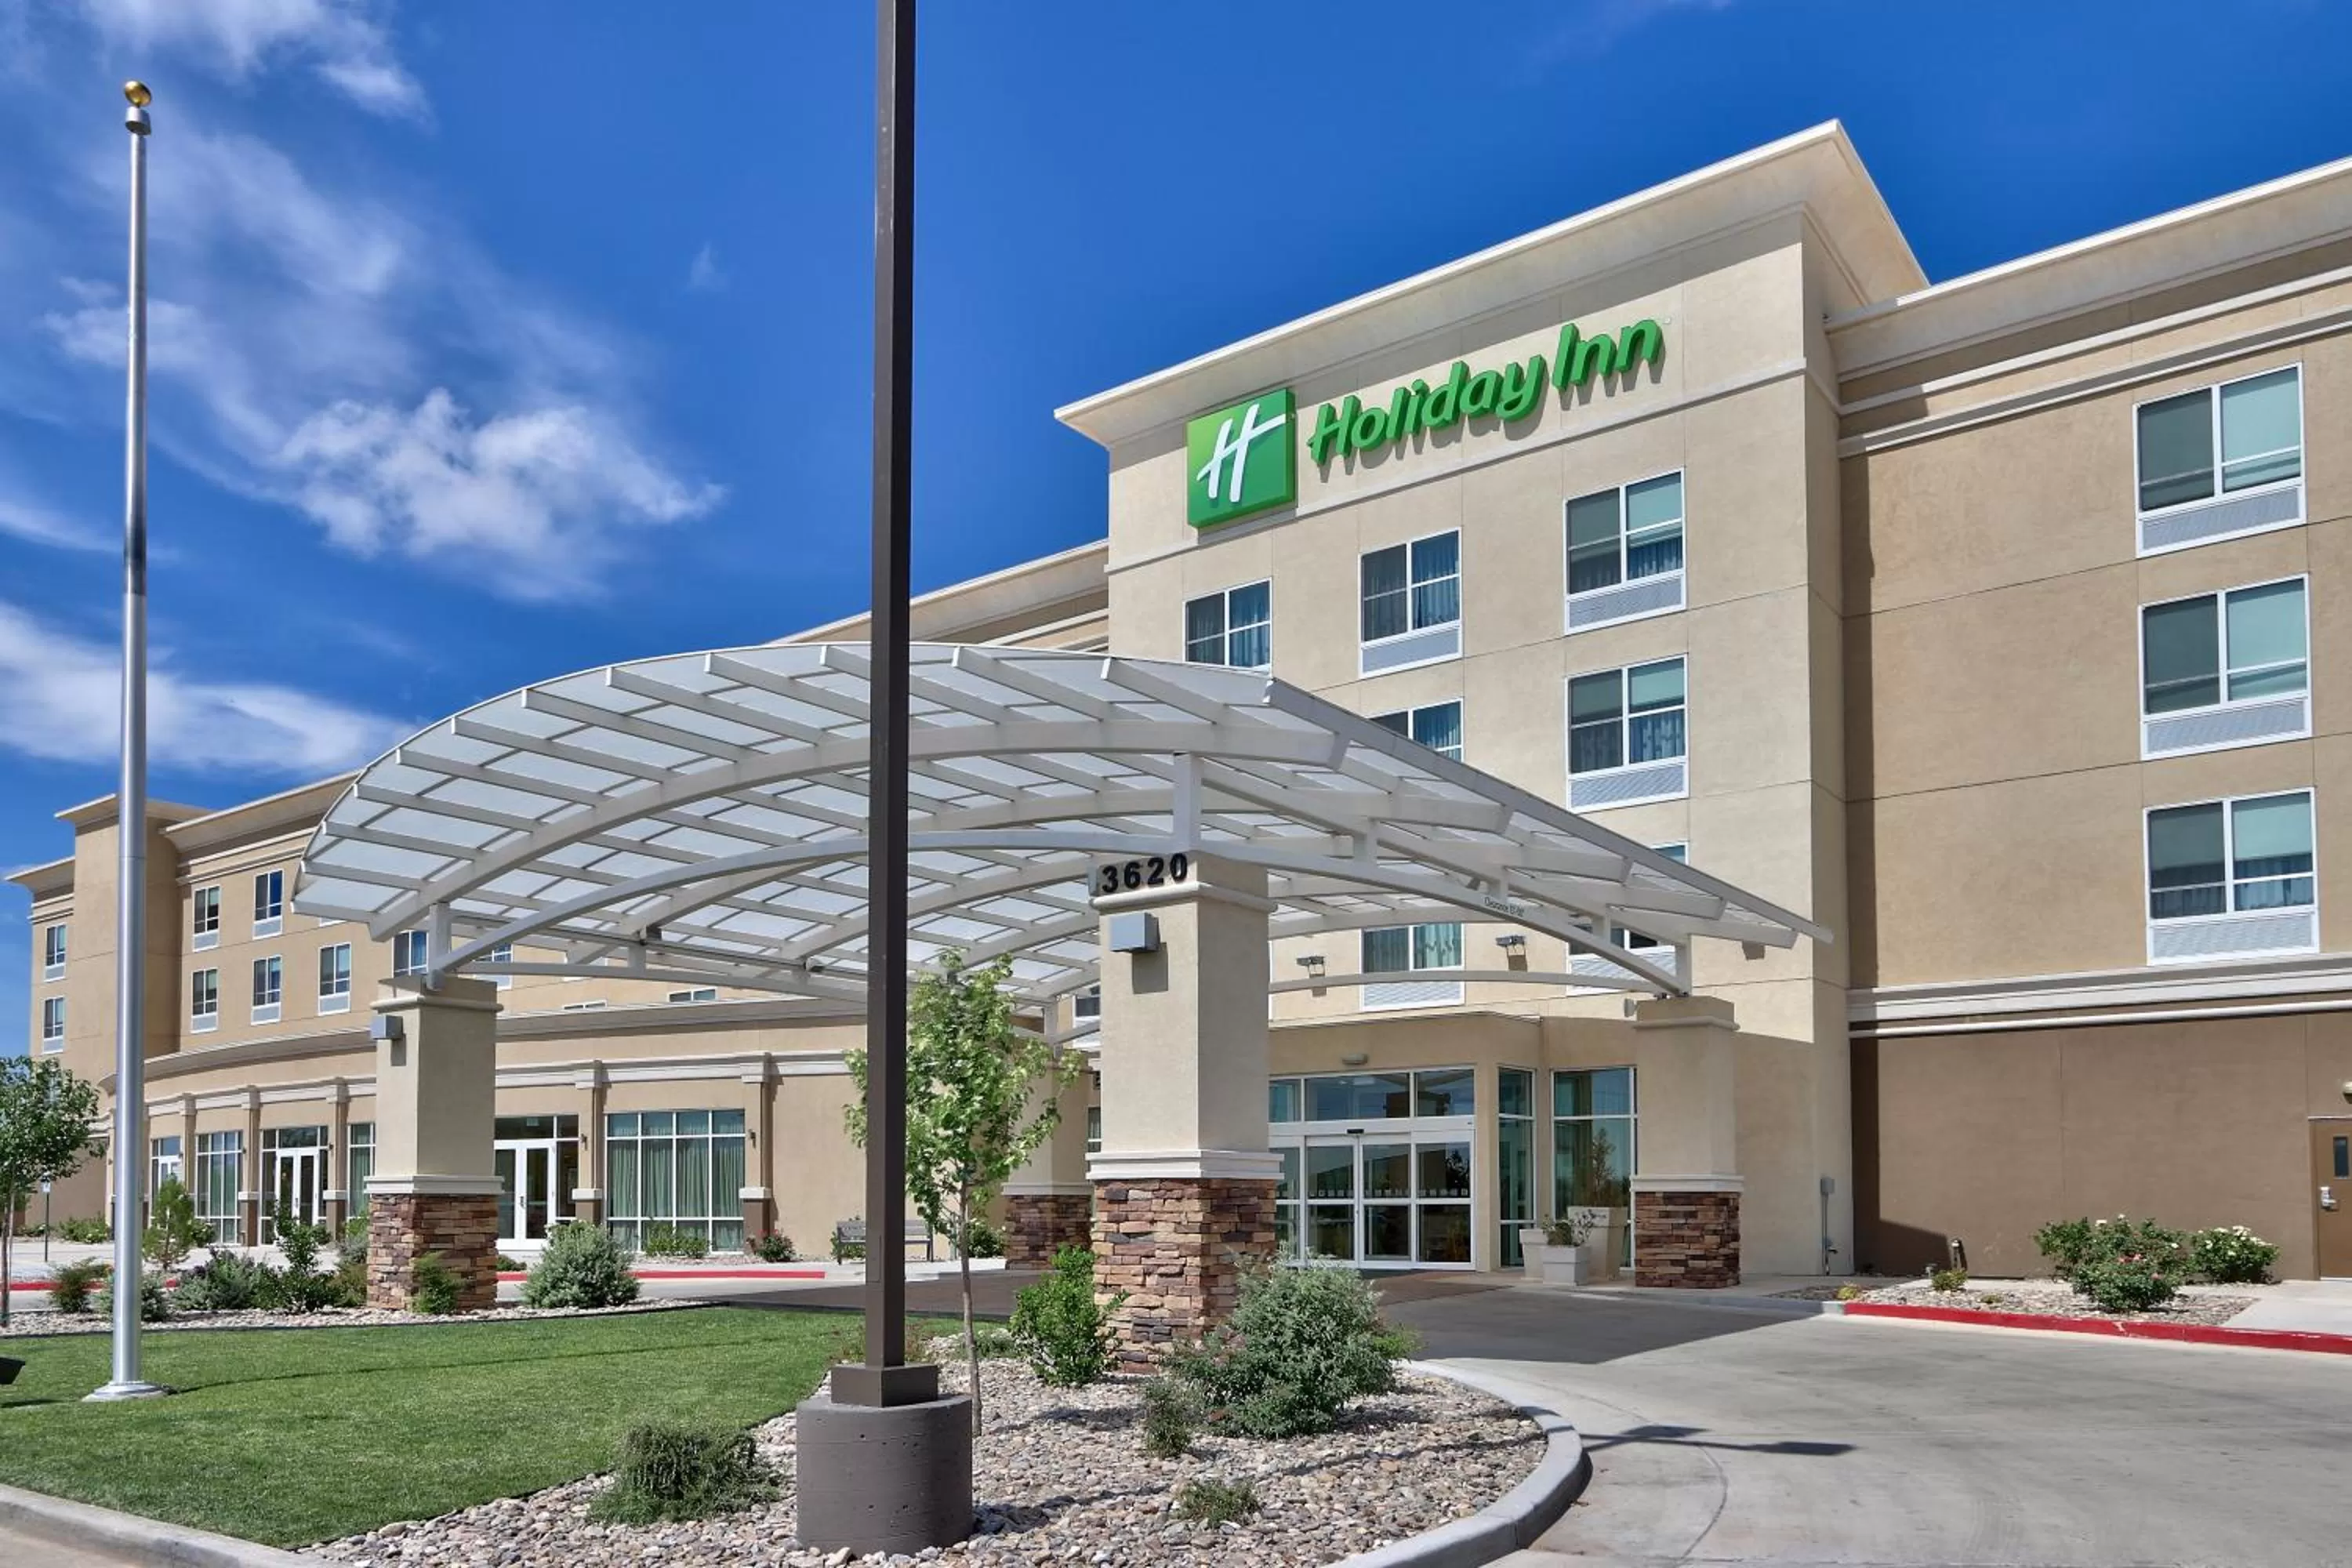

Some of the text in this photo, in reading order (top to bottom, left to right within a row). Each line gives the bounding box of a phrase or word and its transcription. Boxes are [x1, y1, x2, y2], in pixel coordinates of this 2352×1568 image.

[1307, 320, 1664, 465] Holiday Inn
[1102, 852, 1188, 893] 3620
